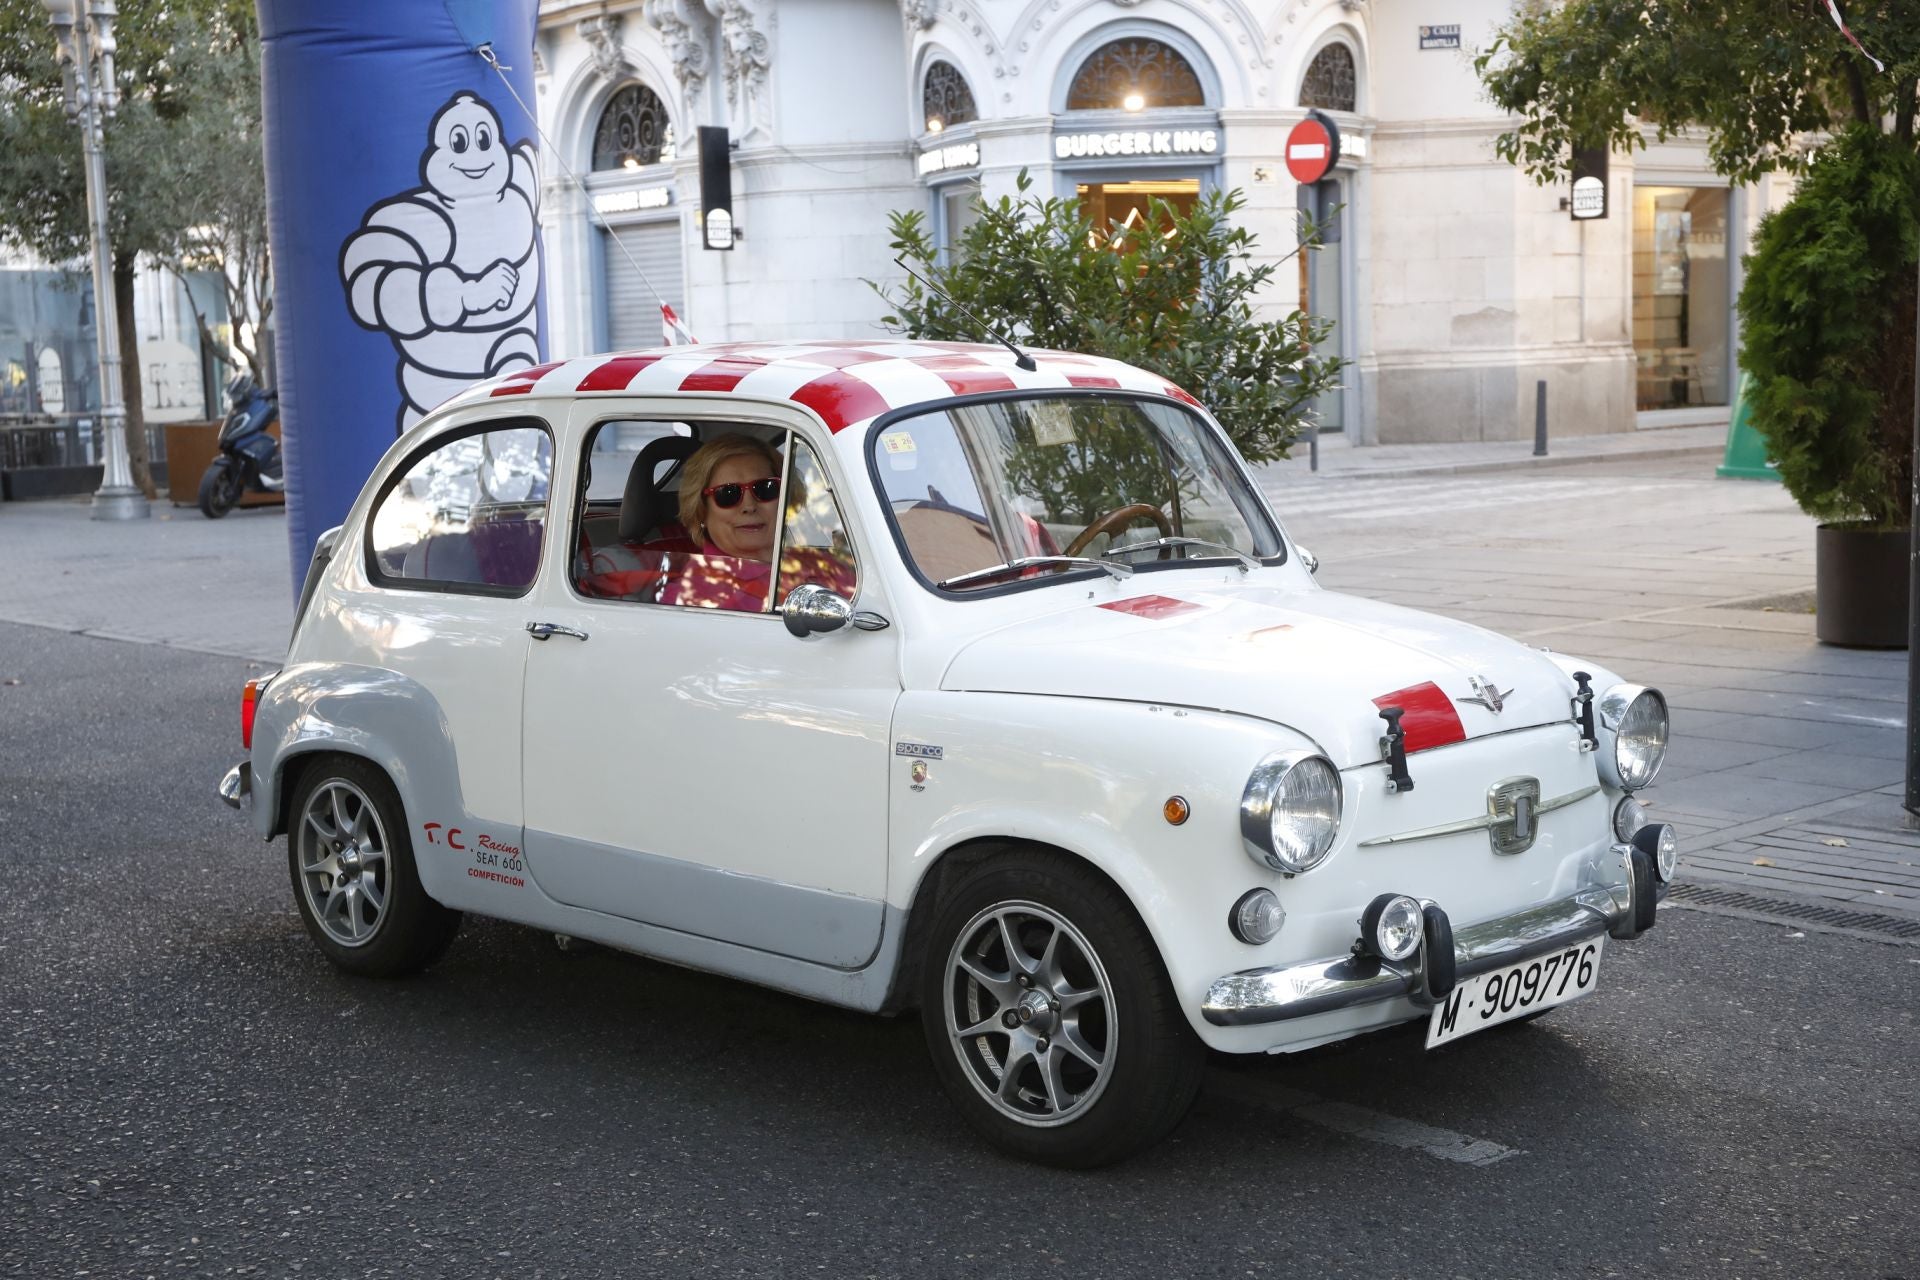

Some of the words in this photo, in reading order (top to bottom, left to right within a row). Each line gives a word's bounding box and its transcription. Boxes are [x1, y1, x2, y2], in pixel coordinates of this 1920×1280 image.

[1055, 132, 1151, 158] BURGER
[1153, 131, 1217, 153] KING
[897, 743, 943, 756] sparco
[479, 835, 520, 858] Racing
[476, 851, 498, 867] SEAT
[503, 857, 522, 872] 600
